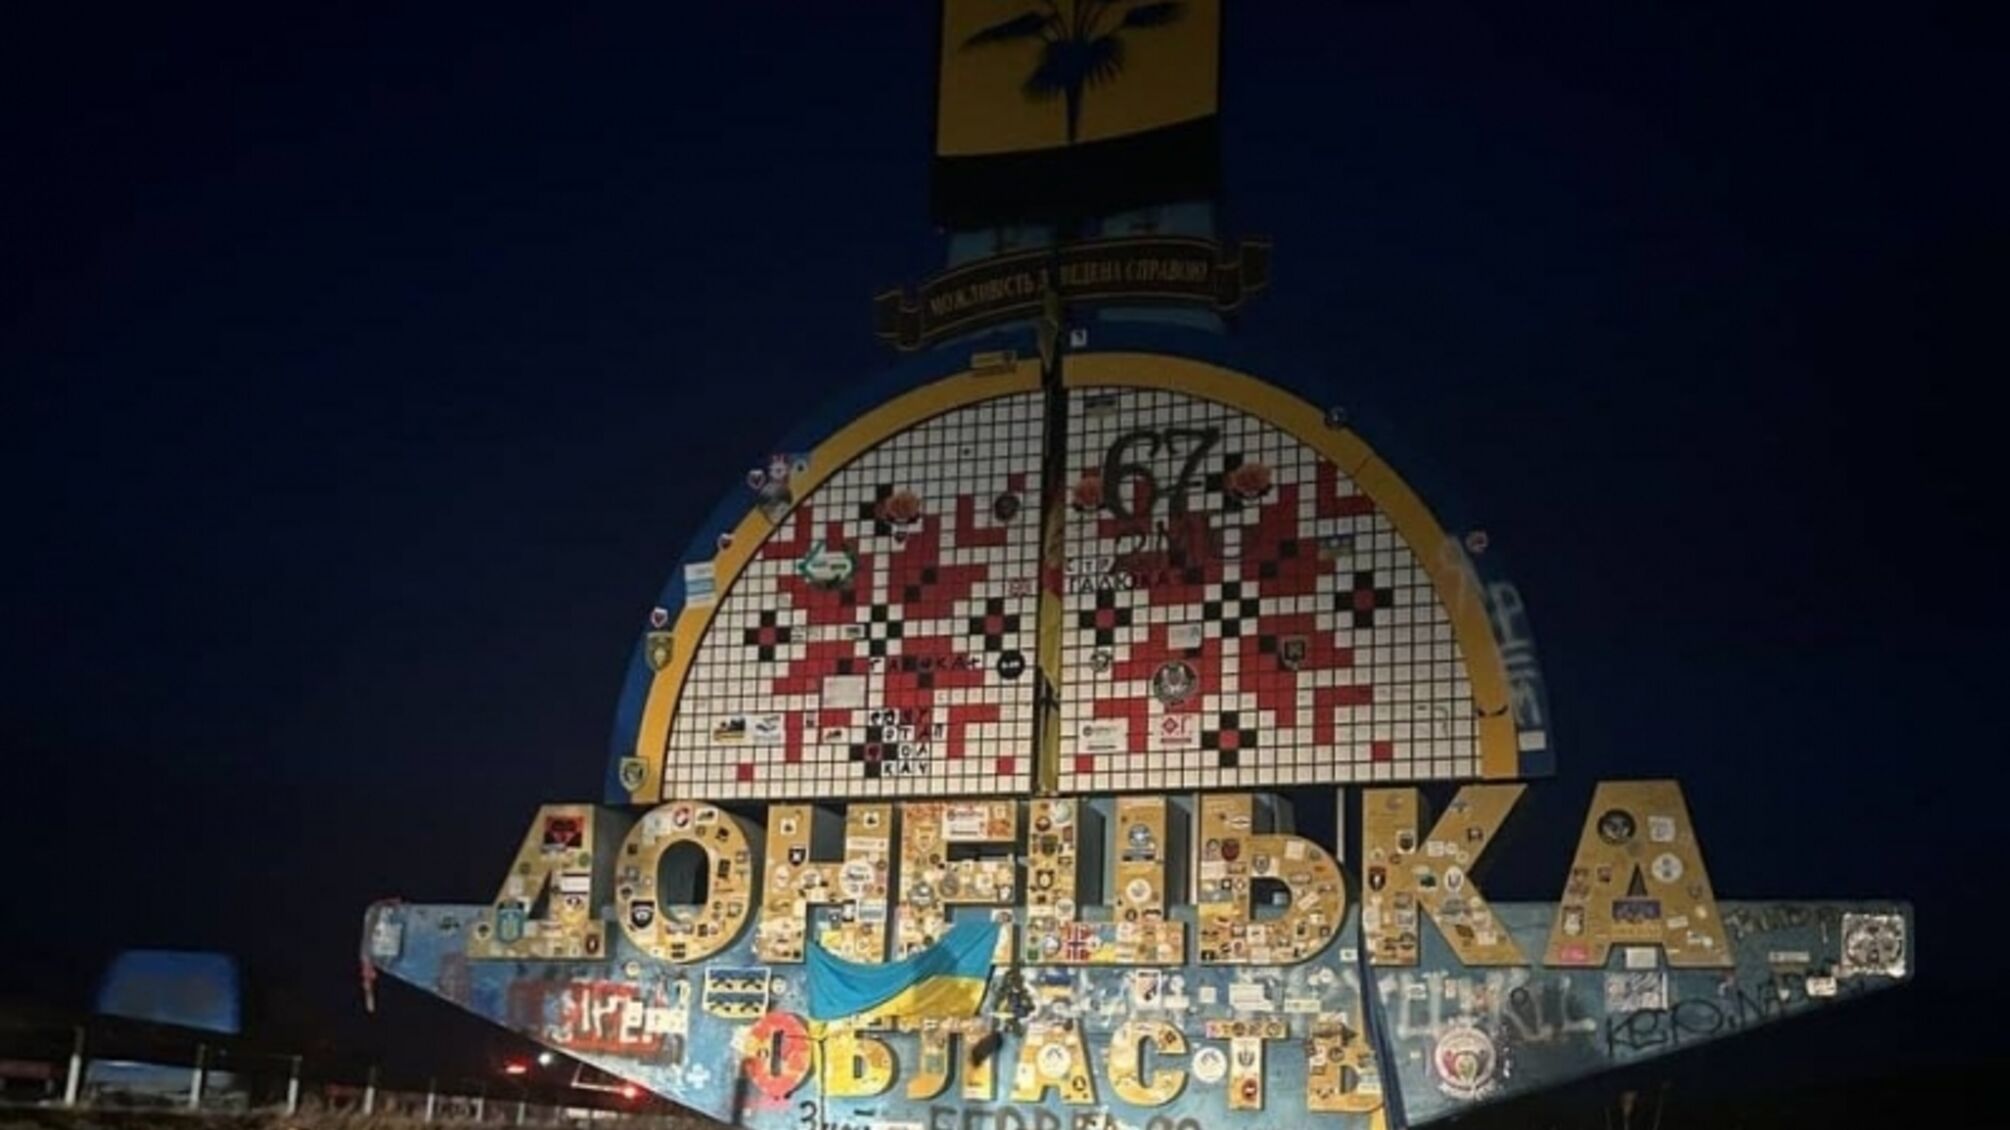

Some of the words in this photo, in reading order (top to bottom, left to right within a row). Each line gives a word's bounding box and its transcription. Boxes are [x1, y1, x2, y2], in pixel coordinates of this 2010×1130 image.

[1104, 425, 1221, 523] 67
[466, 778, 1737, 969] ДОНЕЦЬКА
[743, 1010, 1386, 1113] ОБЛАСТЬ
